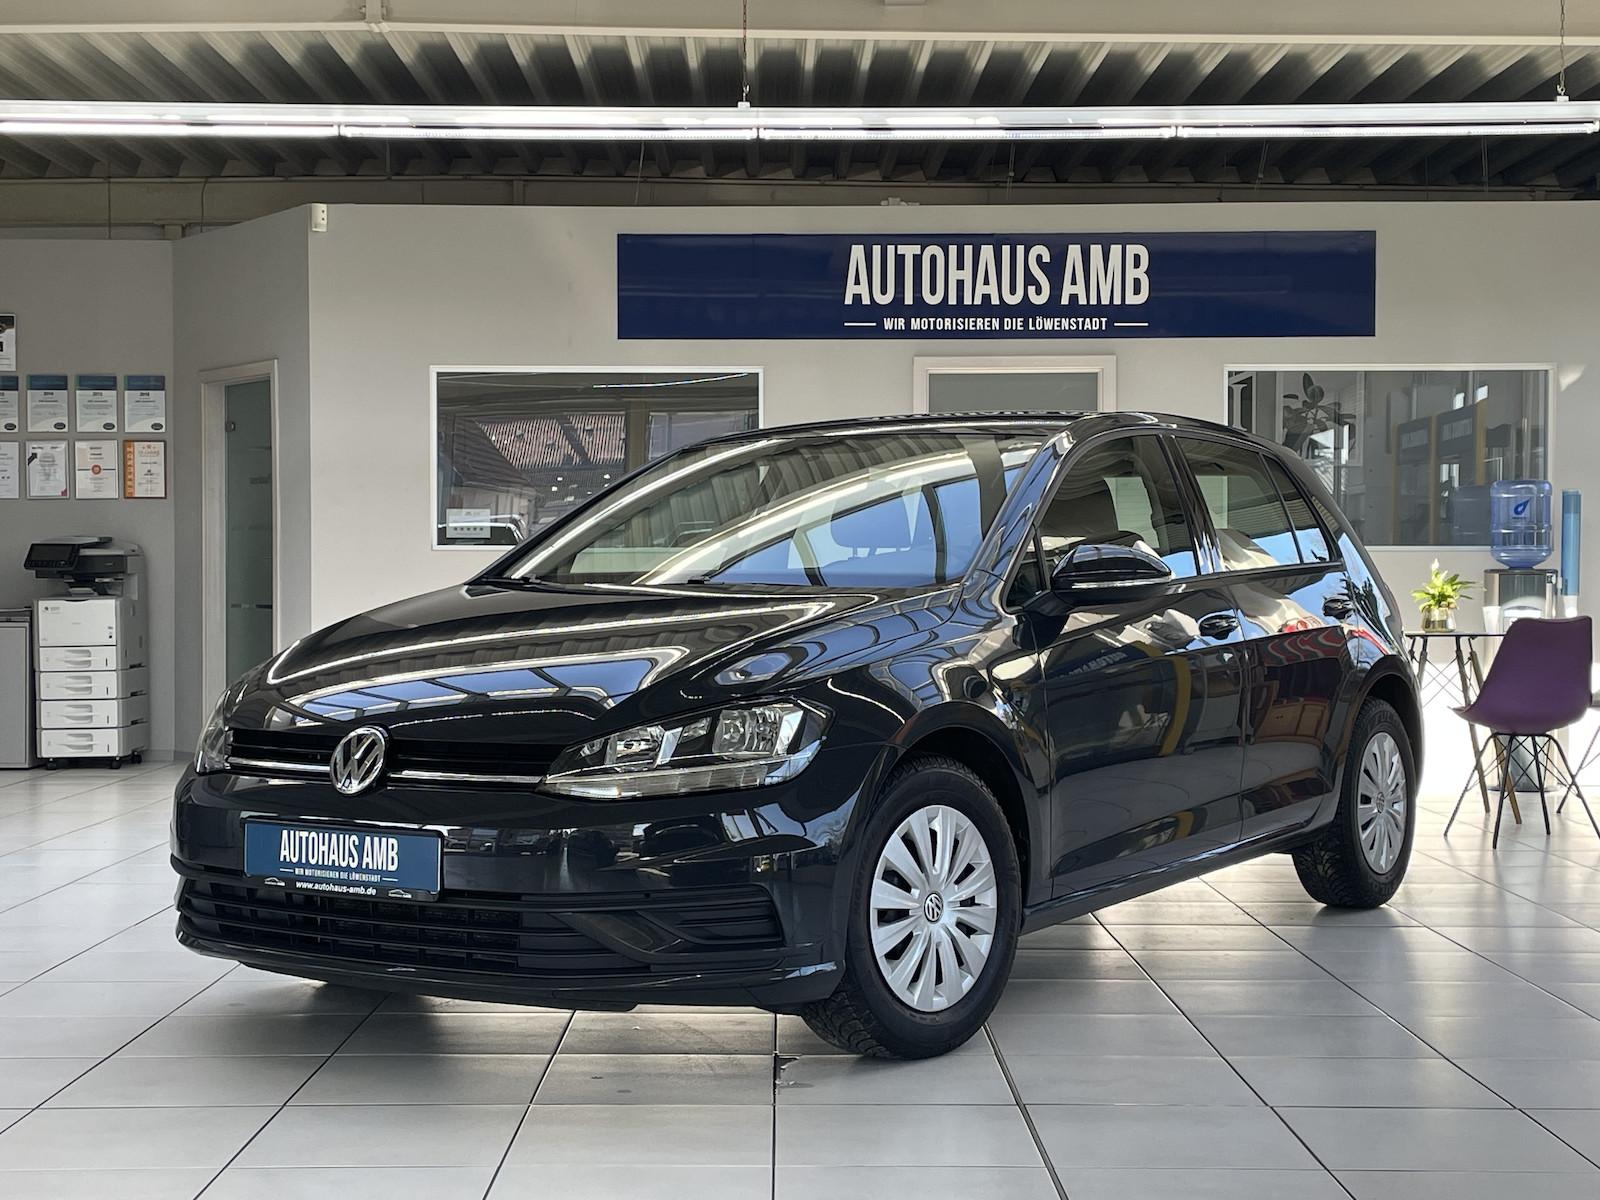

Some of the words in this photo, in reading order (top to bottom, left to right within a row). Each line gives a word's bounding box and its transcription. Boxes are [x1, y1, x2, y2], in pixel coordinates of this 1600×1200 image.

[844, 244, 1051, 306] AUTOHAUS
[1060, 244, 1150, 306] AMB
[883, 318, 905, 331] WIR
[911, 318, 1000, 331] MOTORISIEREN
[1003, 318, 1023, 331] DIE
[1028, 316, 1108, 331] LÖWENSTADT
[280, 829, 359, 868] AUTOHAUS
[362, 836, 399, 872] AMB
[295, 881, 377, 896] www.autohaus-amb.de
